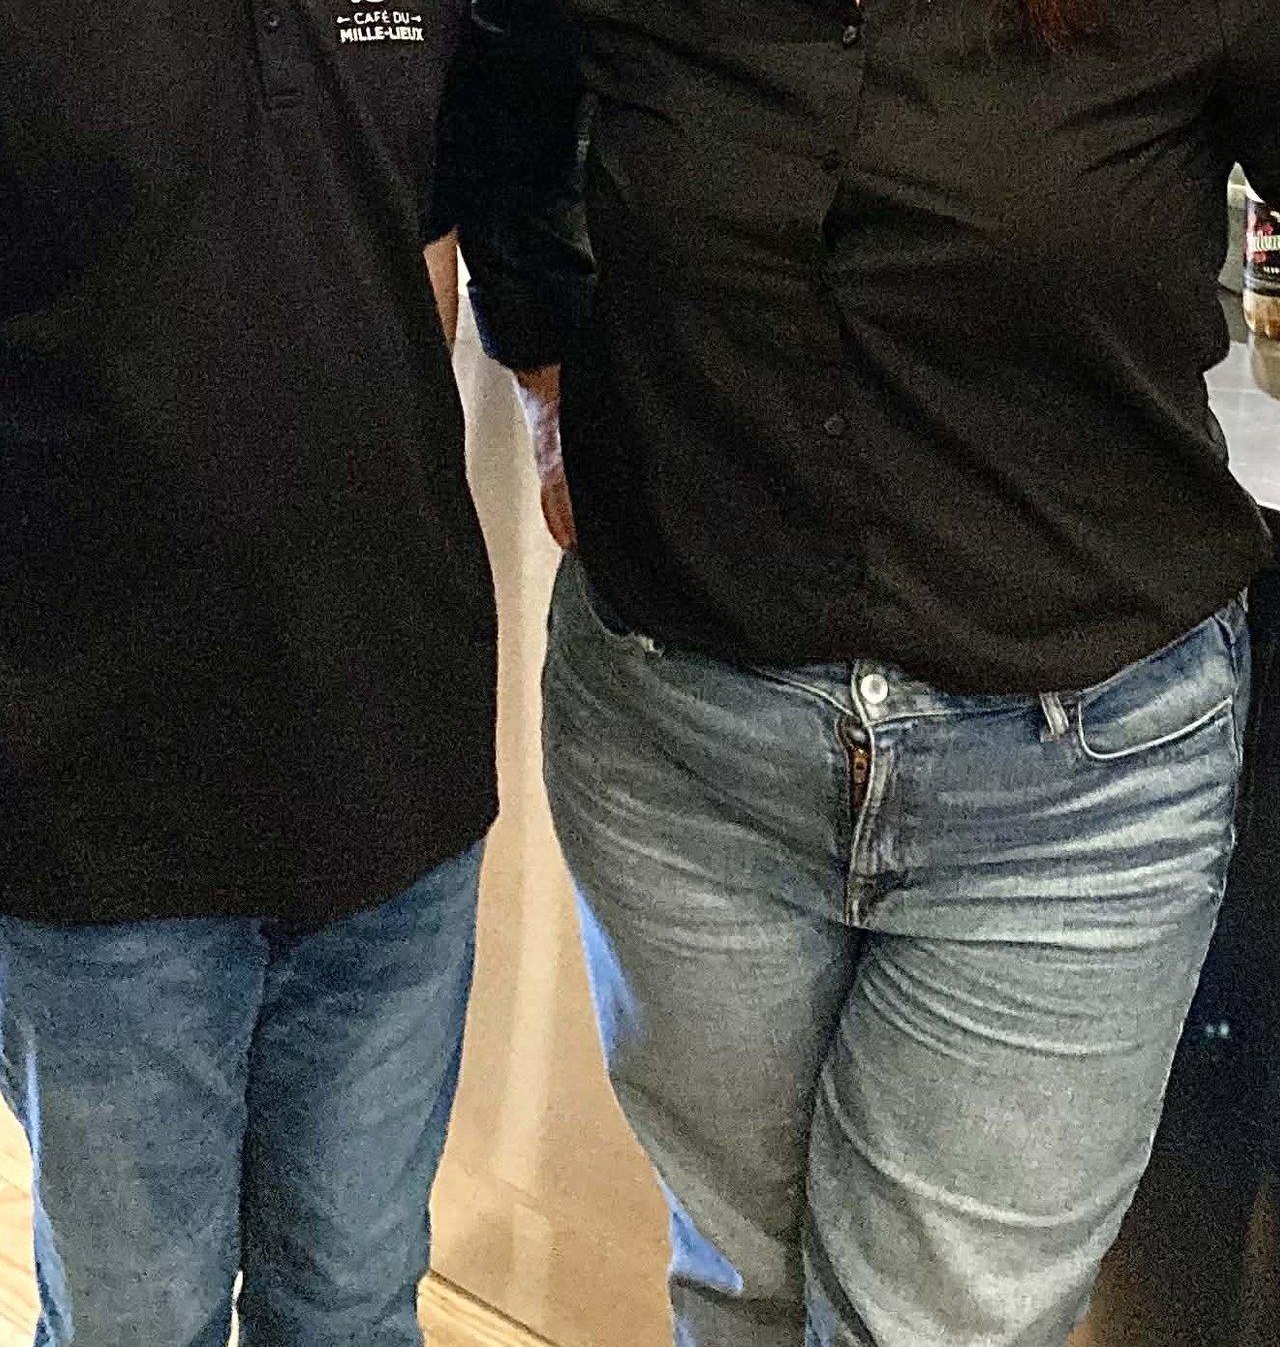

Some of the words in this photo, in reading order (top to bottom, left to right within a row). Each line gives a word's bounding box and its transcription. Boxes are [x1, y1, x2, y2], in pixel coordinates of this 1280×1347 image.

[353, 9, 390, 25] CAFÉ
[393, 11, 410, 24] DU
[340, 26, 424, 43] MILLE-LIEUX
